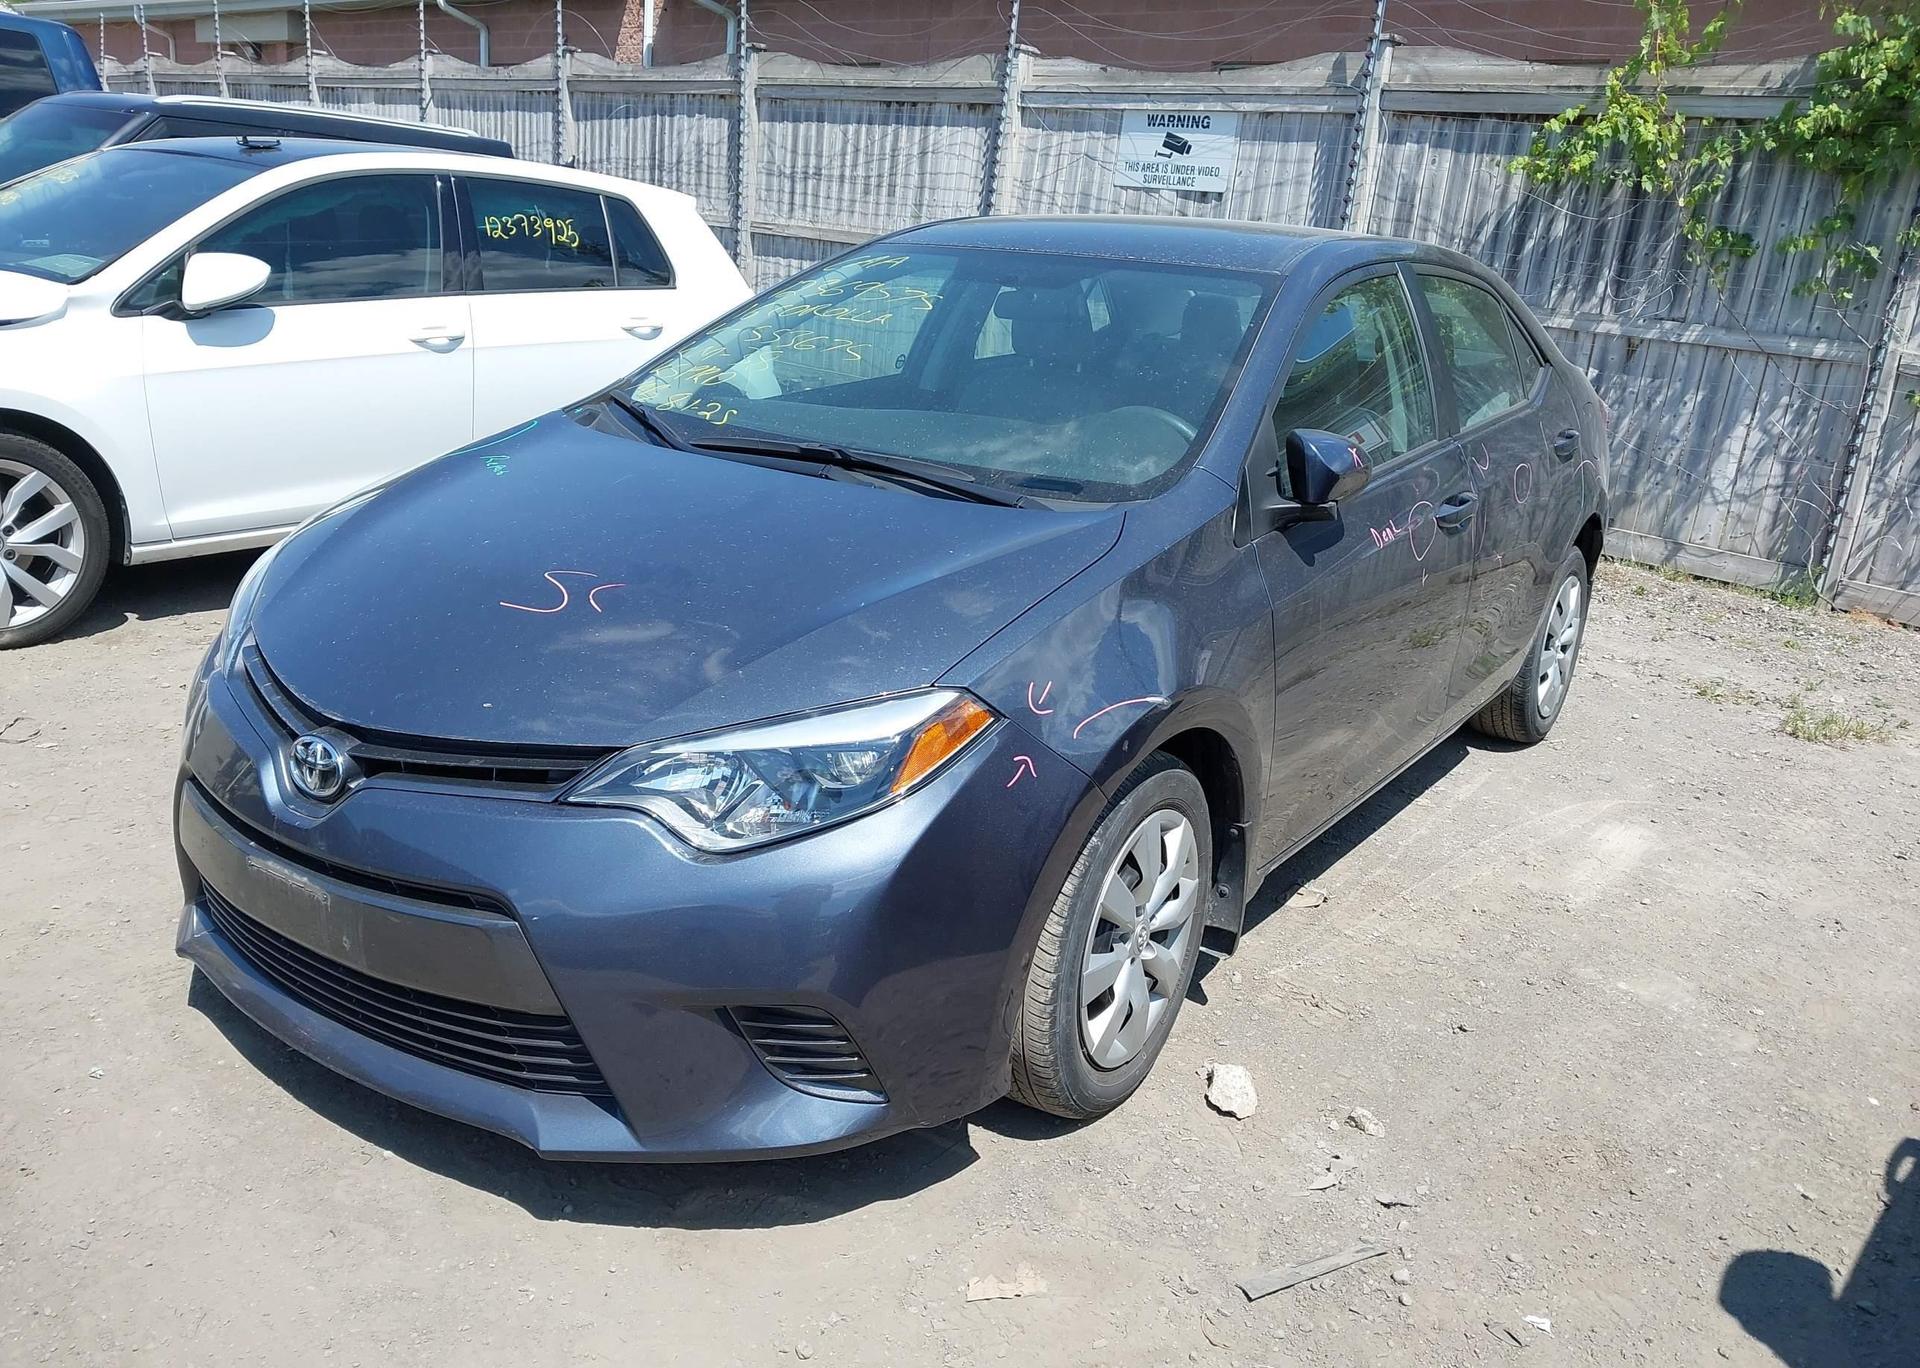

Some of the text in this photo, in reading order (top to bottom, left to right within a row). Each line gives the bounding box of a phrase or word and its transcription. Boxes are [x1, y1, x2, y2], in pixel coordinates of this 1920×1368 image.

[1147, 113, 1211, 129] WARNING
[1124, 161, 1220, 177] THIS AREA IS UNDER VIDEO
[1142, 173, 1196, 187] SURVEILLANCE
[484, 213, 579, 247] 12373925
[767, 303, 893, 325] COROLLA
